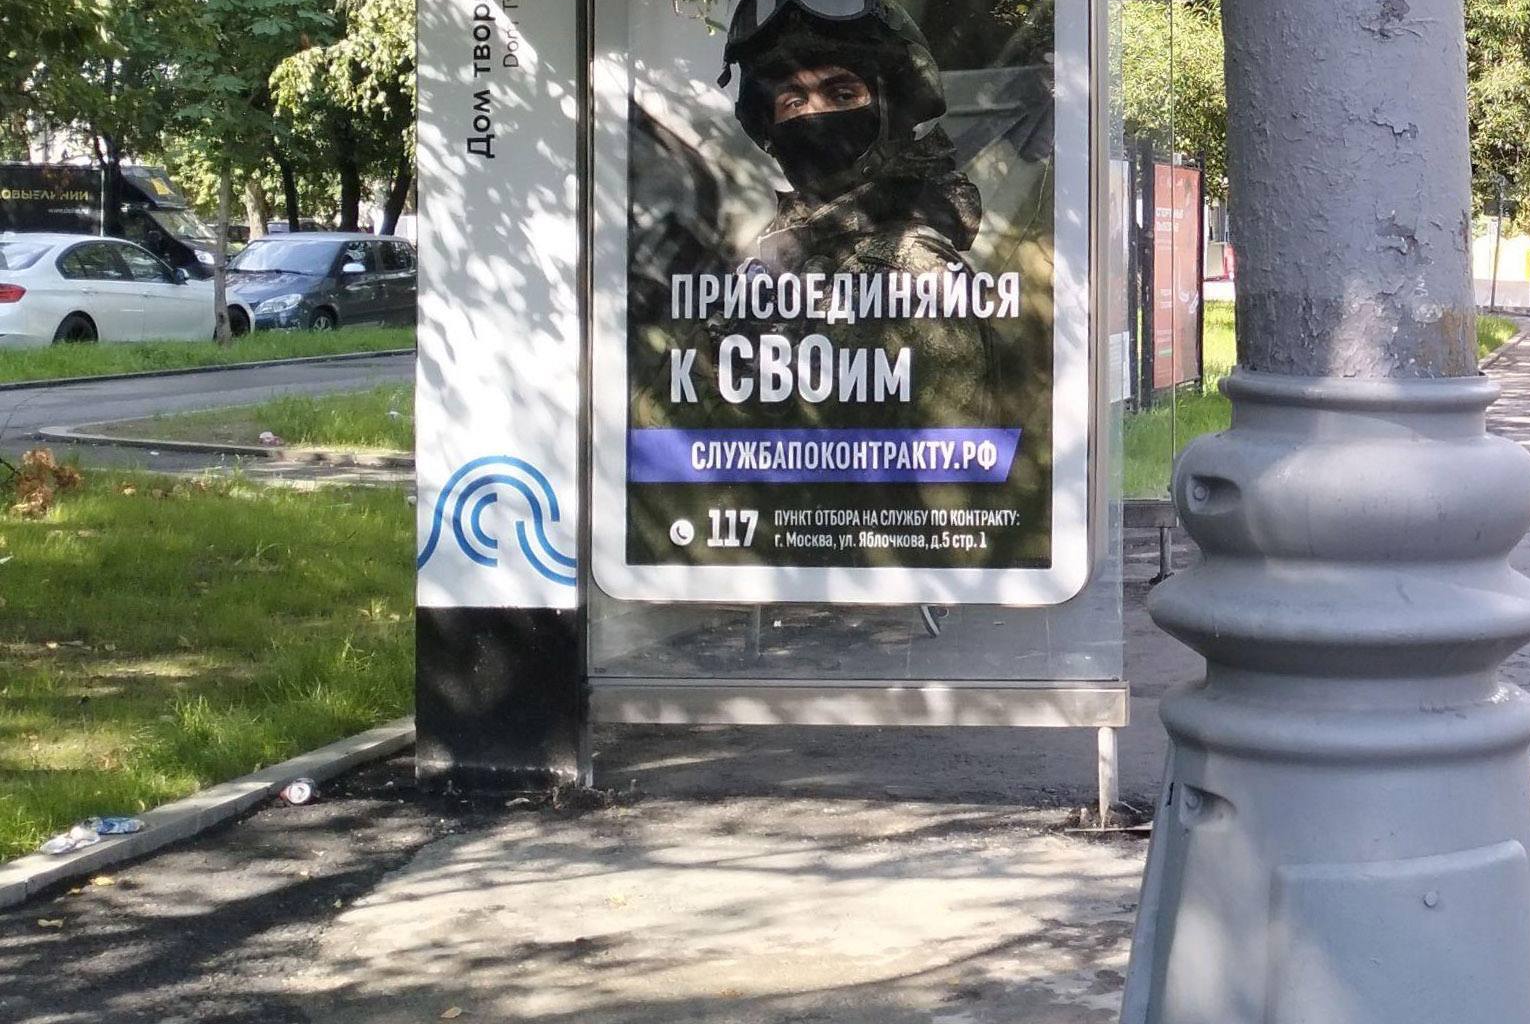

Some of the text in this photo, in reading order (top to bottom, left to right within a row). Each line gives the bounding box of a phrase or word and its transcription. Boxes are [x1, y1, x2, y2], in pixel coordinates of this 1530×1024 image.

[467, 89, 495, 159] Дом
[671, 263, 1020, 324] ПРИСОЕДИНЯЙСЯ
[690, 440, 998, 472] СЛУЖБАПОКОНТРАКТУ.РФ
[707, 510, 758, 547] 117
[774, 510, 1020, 526] ПУНКТ ОТБОРА НА СЛУЖБУ ПО КОНТРАКТУ:
[774, 532, 988, 551] г. Москва, ул. Яблочкова, д.5 стр. 1
